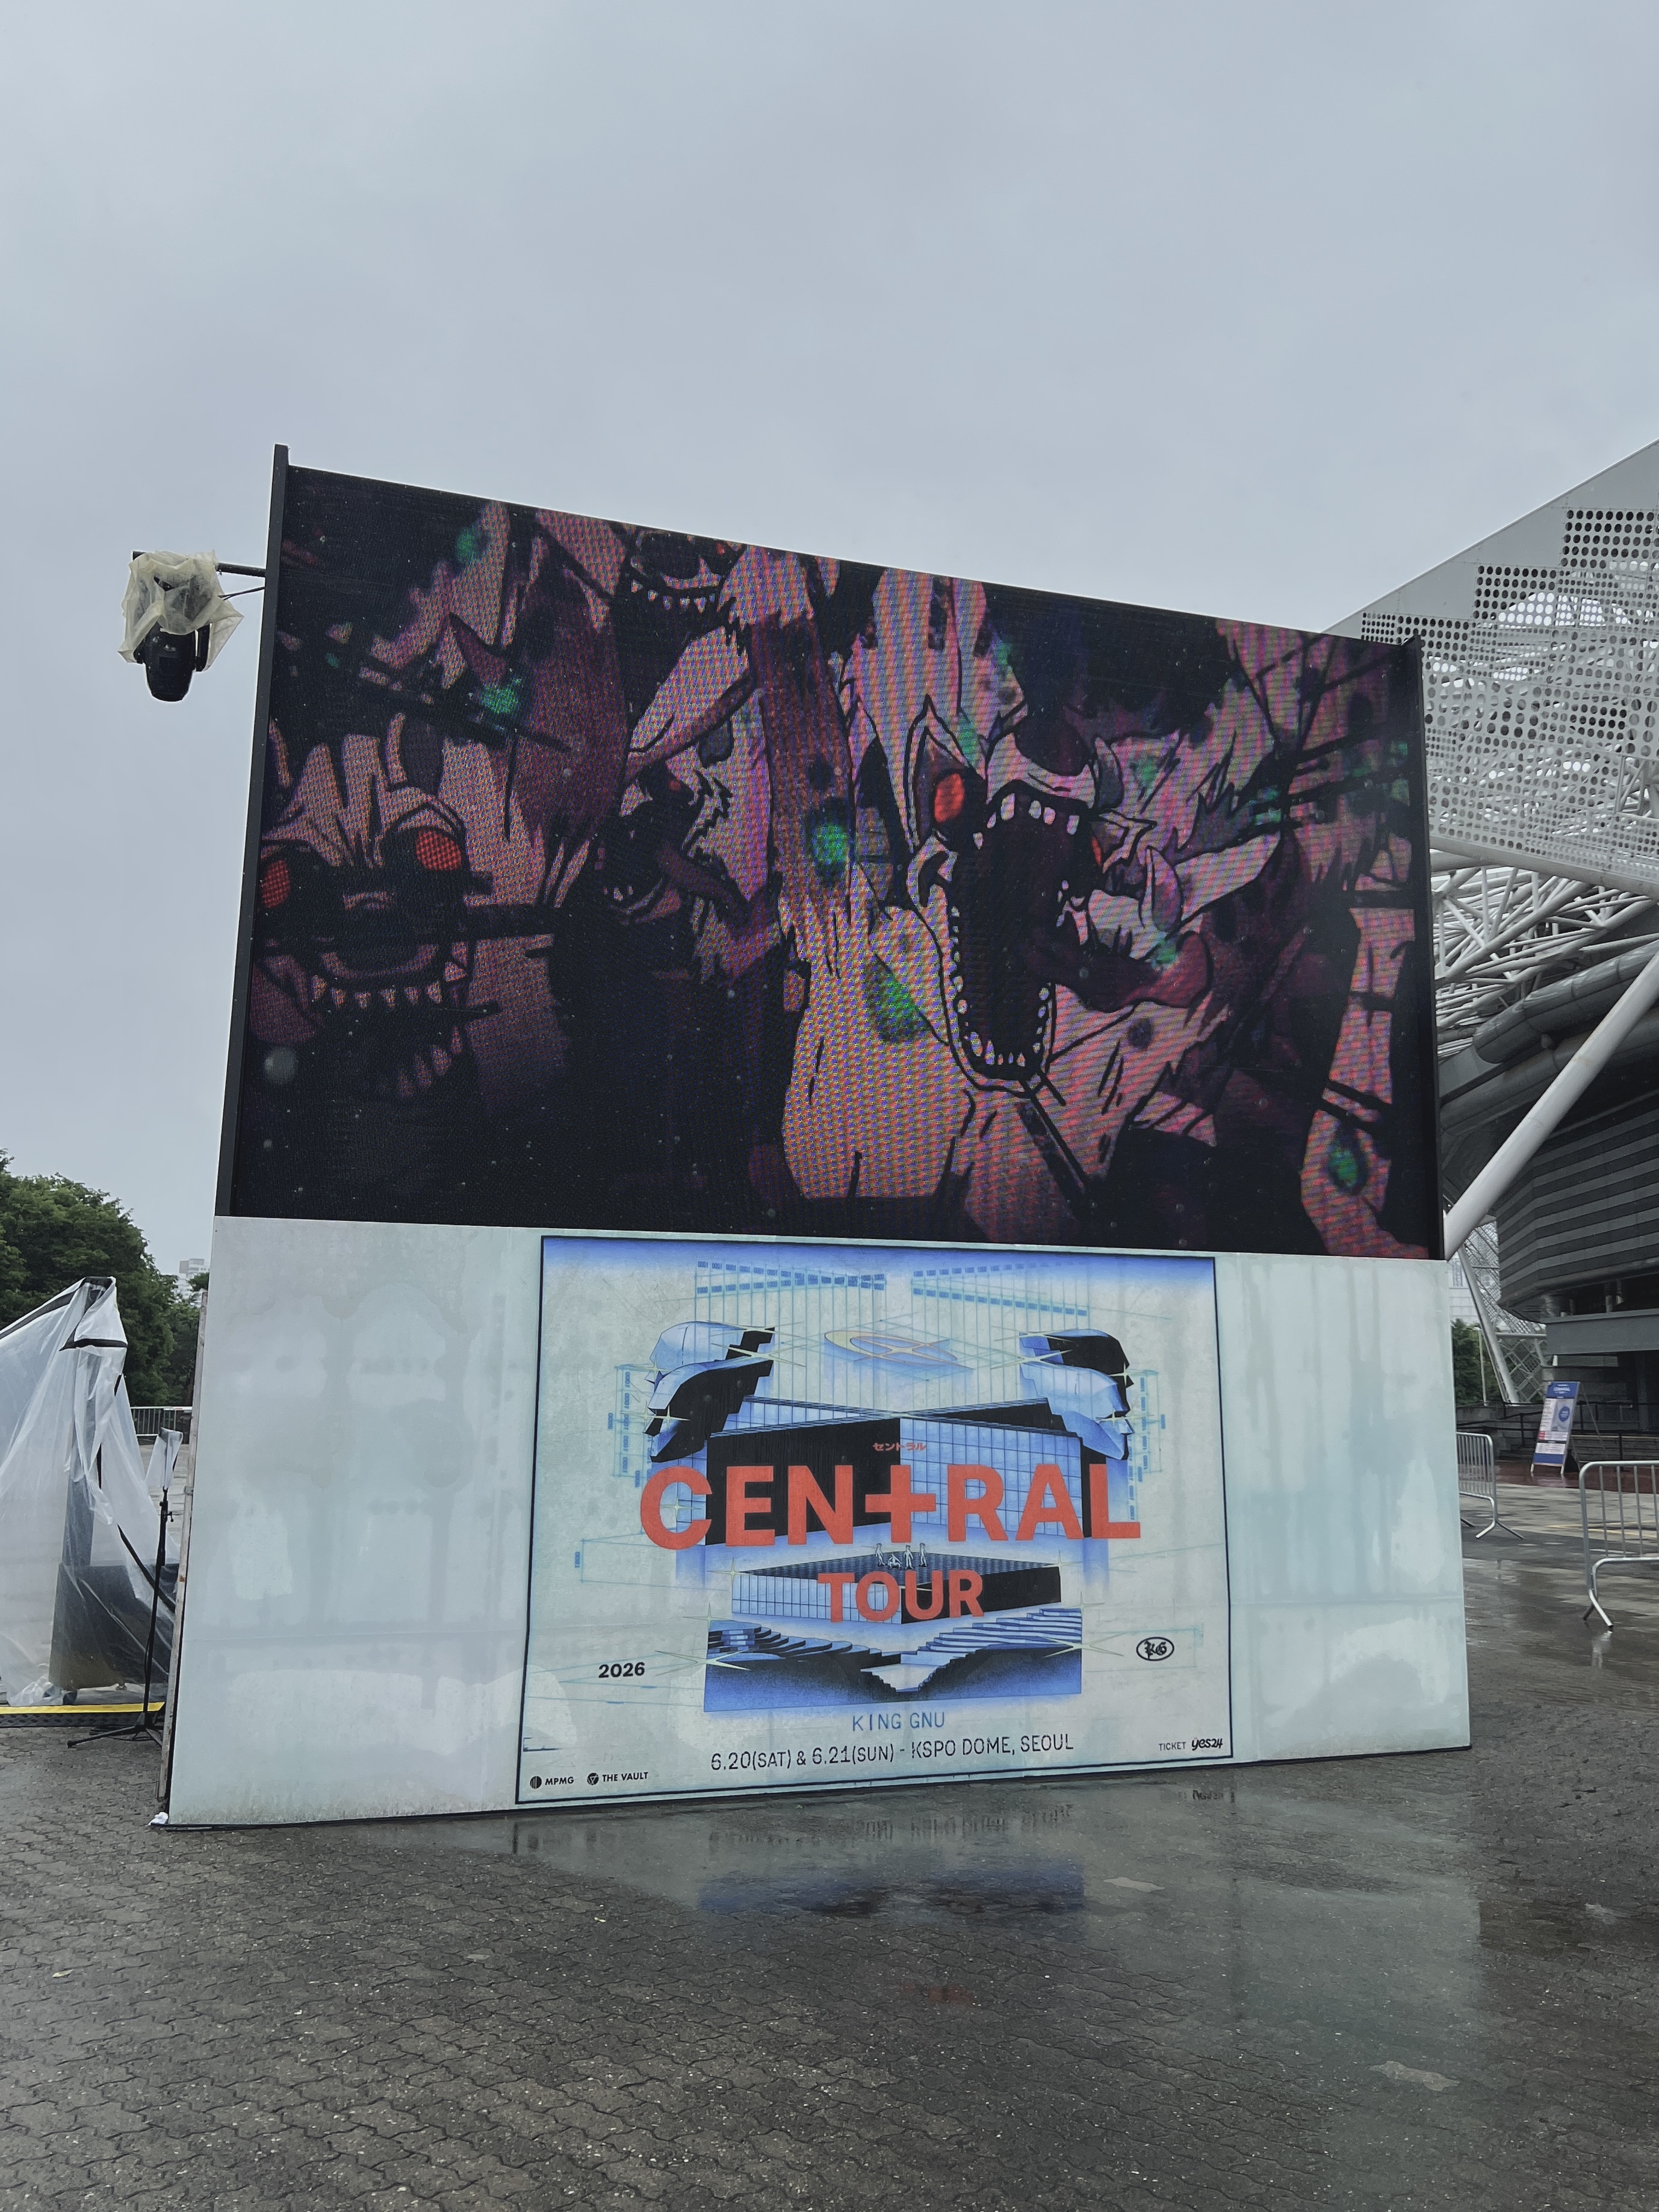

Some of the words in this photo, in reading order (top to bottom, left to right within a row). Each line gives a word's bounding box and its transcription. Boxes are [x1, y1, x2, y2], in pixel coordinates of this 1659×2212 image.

[873, 1442, 926, 1452] セントラル
[818, 1570, 984, 1622] TOUR
[598, 1662, 645, 1679] 2026
[852, 1713, 901, 1732] KING
[910, 1712, 944, 1729] GNU
[711, 1749, 791, 1771] 6.20(SAT)
[796, 1751, 807, 1765] &
[812, 1743, 894, 1765] 6.21(SUN)
[911, 1740, 956, 1759] KSPO
[963, 1736, 1015, 1756] DOME,
[1020, 1733, 1074, 1752] SEOUL
[1158, 1741, 1186, 1751] TICKET
[1191, 1738, 1223, 1751] yes24
[545, 1776, 574, 1786] MPMG
[602, 1774, 618, 1782] THE
[621, 1771, 649, 1781] VAULT
